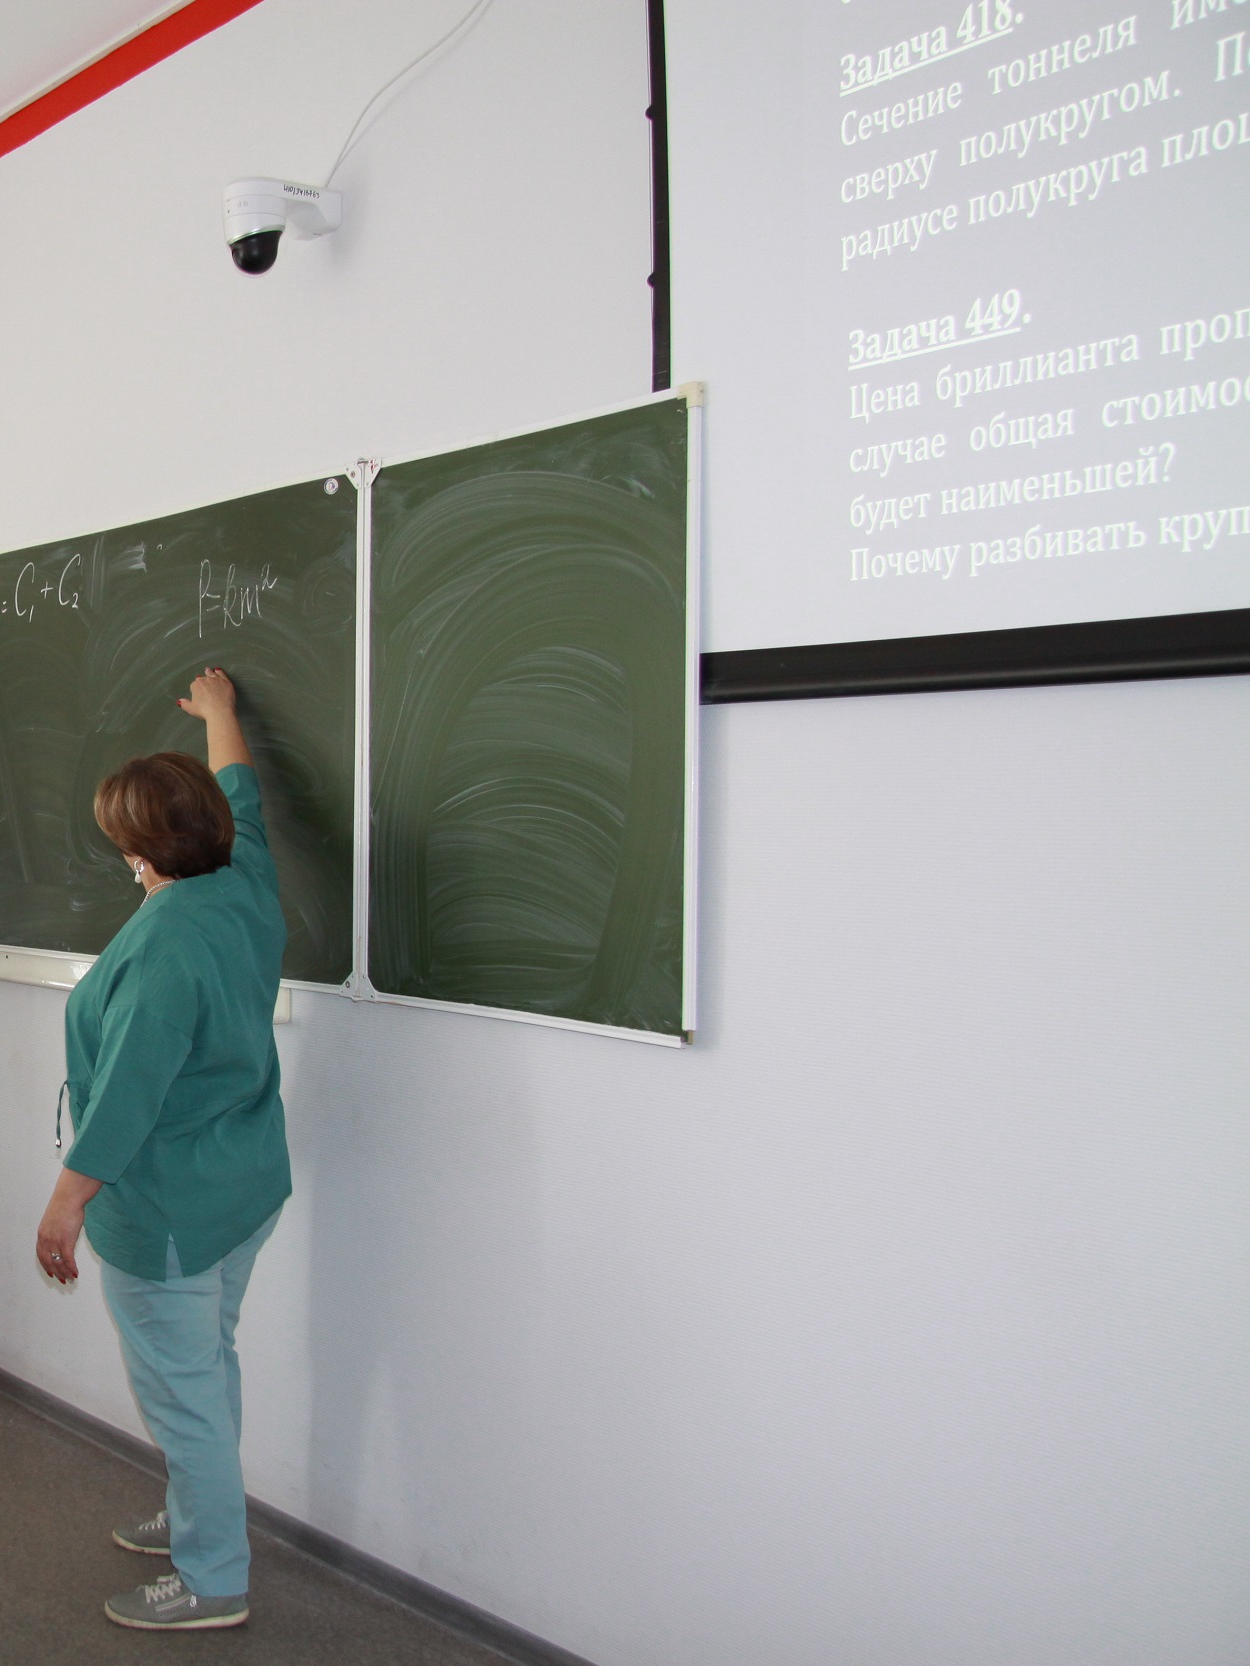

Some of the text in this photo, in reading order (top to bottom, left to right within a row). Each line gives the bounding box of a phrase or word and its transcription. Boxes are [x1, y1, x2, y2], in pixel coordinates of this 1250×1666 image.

[839, 0, 1024, 96] Задача 418.
[840, 82, 963, 146] Сечение
[987, 15, 1138, 95] тоннеля
[840, 149, 938, 203] сверху
[959, 70, 1182, 167] полукругом.
[840, 204, 958, 271] радиусе
[968, 146, 1148, 225] полукруга
[848, 289, 1031, 370] Задача 449.
[850, 381, 921, 423] Цена
[936, 333, 1140, 408] бриллианта
[850, 433, 947, 477] случае
[969, 408, 1075, 452] общая
[850, 442, 1176, 535] будет наименьшей?
[850, 543, 961, 582] Почему
[968, 521, 1147, 577] разбивать
